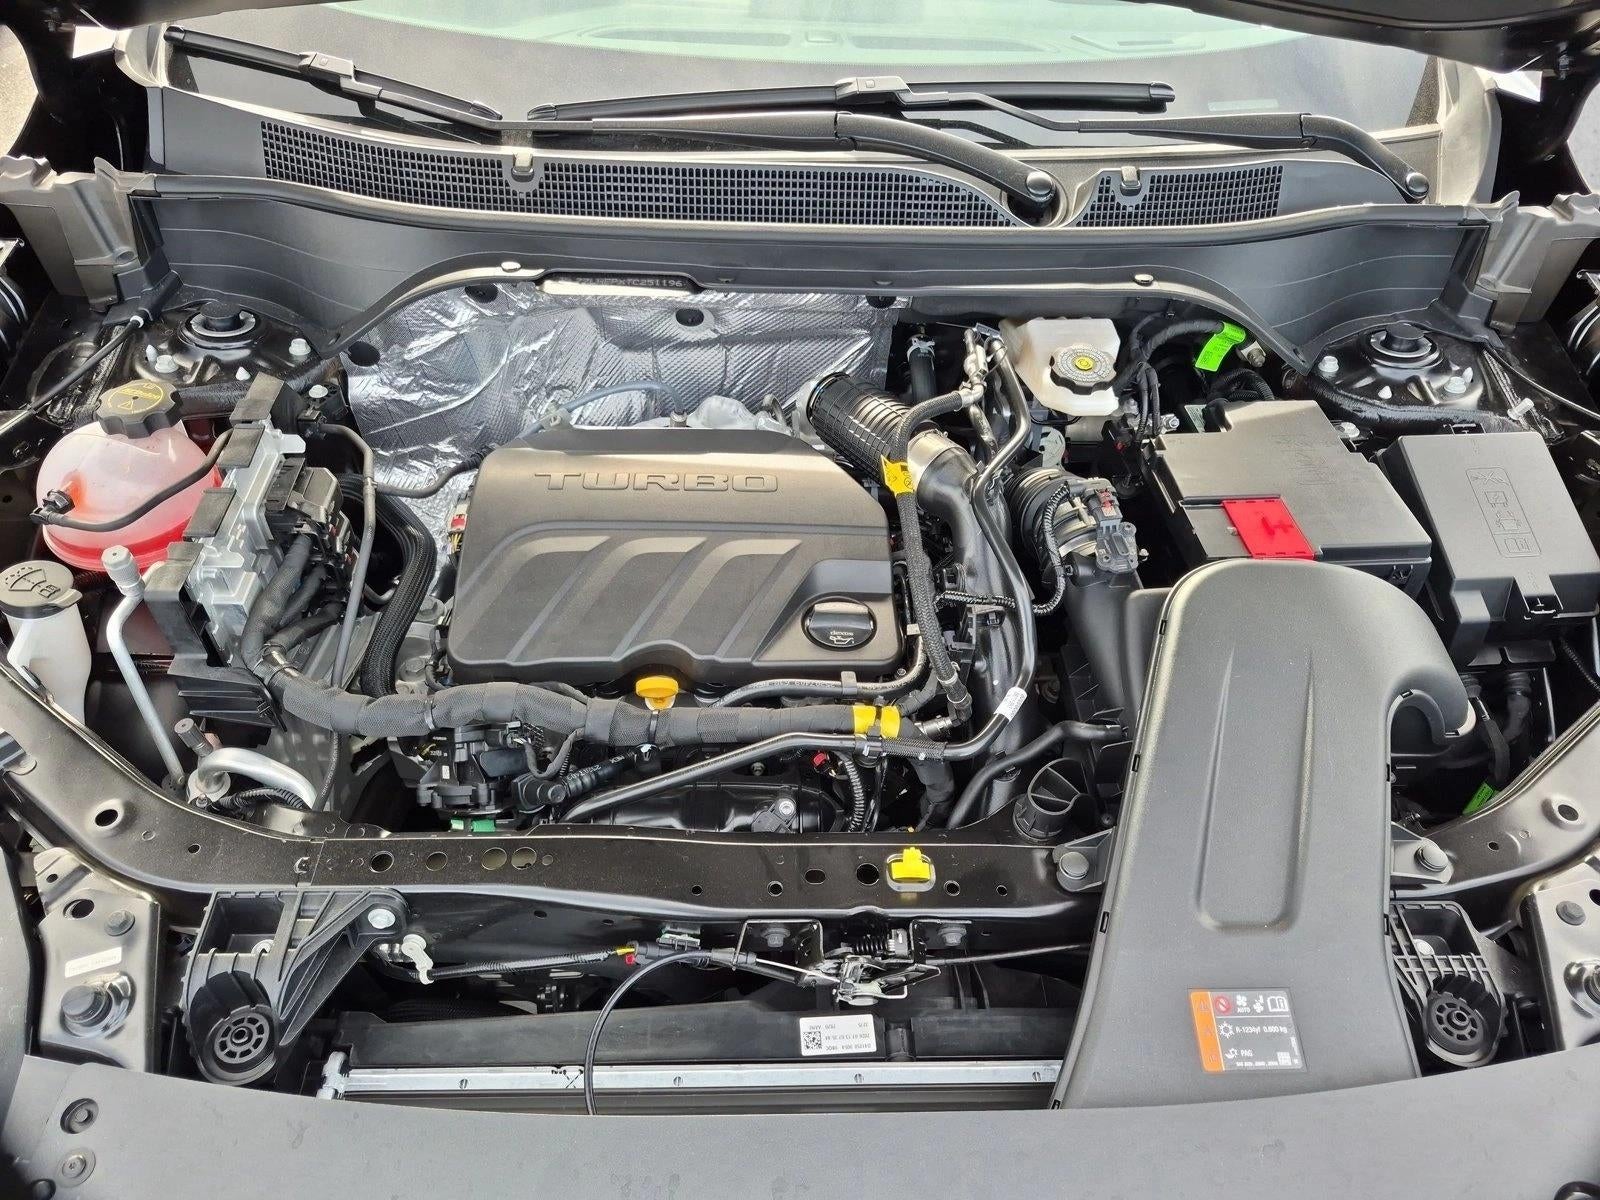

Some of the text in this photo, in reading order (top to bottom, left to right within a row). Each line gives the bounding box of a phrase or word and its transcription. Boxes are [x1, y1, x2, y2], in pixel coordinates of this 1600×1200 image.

[534, 471, 778, 492] TURBO
[1235, 1026, 1261, 1035] R-1234yf
[1240, 1049, 1253, 1057] PAG
